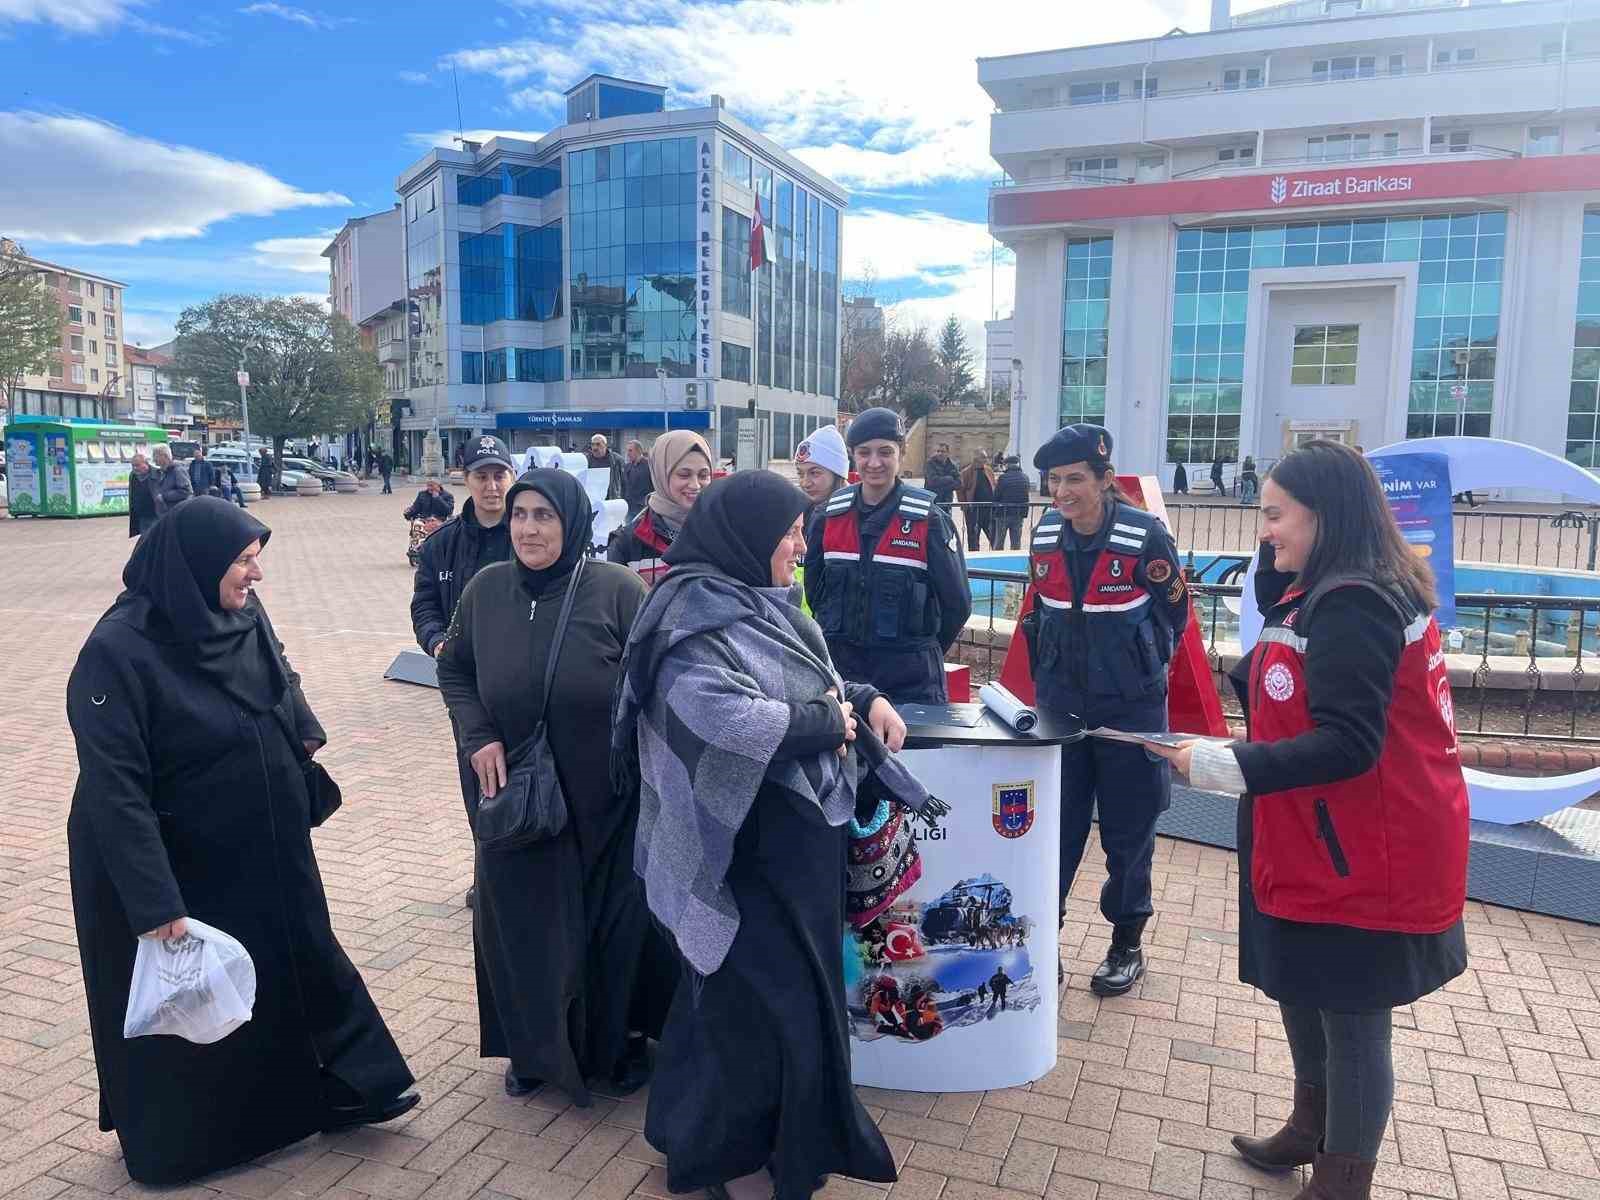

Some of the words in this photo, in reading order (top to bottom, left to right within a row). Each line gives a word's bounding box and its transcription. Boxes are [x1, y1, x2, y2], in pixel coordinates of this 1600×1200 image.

[701, 141, 711, 213] ALACA
[1291, 178, 1341, 198] Ziraat
[1345, 176, 1412, 194] Bankası
[1383, 479, 1412, 492] NİM
[1416, 480, 1437, 489] VAR
[1099, 584, 1133, 592] JANDARMA
[913, 825, 947, 840] LIĞI
